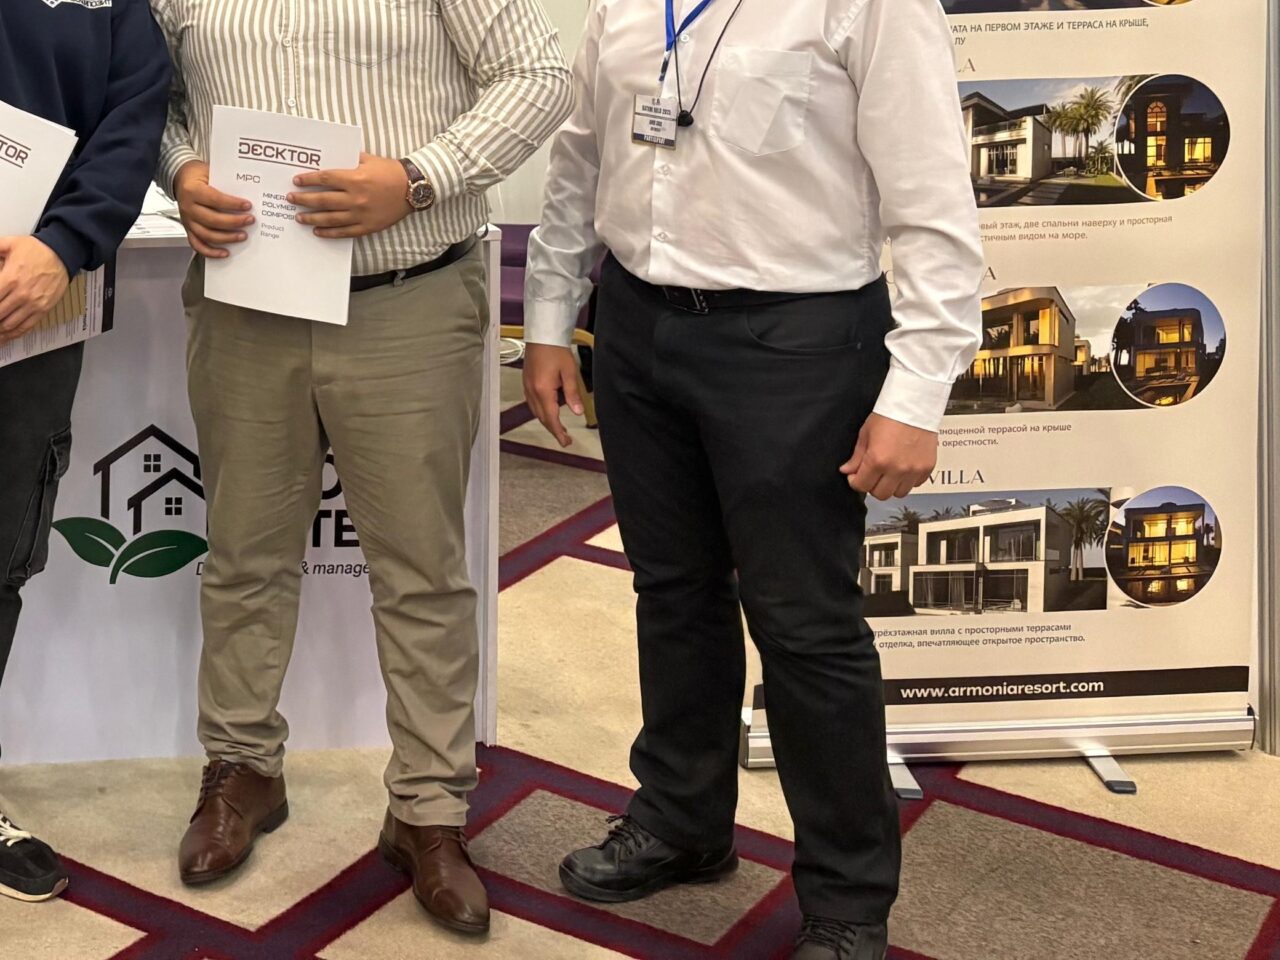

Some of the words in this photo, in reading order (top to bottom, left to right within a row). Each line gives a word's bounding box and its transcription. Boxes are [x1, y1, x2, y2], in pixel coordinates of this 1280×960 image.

[951, 24, 968, 34] АТА
[970, 24, 983, 33] НА
[984, 23, 1021, 32] ПЕРВОМ
[1023, 21, 1054, 31] ЭТАЖЕ
[1056, 21, 1065, 30] И
[1067, 20, 1104, 30] ТЕРРАСА
[1106, 19, 1118, 28] НА
[1119, 18, 1149, 28] КРЫШЕ,
[239, 142, 321, 166] DECKTOR
[236, 173, 261, 183] MPC
[262, 201, 297, 211] POLYMER
[261, 210, 295, 220] COMPOSI
[979, 221, 998, 230] вый
[999, 221, 1022, 230] этаж,
[1024, 220, 1040, 230] две
[1042, 218, 1079, 228] спальни
[1081, 218, 1117, 228] наверху
[1120, 218, 1126, 226] и
[1127, 215, 1173, 226] просторная
[1019, 232, 1046, 242] видом
[1048, 232, 1059, 240] на
[1062, 232, 1088, 241] море.
[988, 424, 1027, 435] террасой
[1042, 424, 1072, 433] крыше
[942, 438, 999, 447] окрестности.
[313, 562, 370, 577] manage
[930, 627, 955, 636] вилла
[964, 625, 1024, 635] просторными
[1026, 624, 1071, 633] террасами
[879, 640, 915, 650] отделка,
[917, 638, 980, 648] впечатляющее
[982, 637, 1022, 646] открытое
[1024, 635, 1086, 645] пространство.
[900, 680, 1104, 699] www.armoniaresort.com
